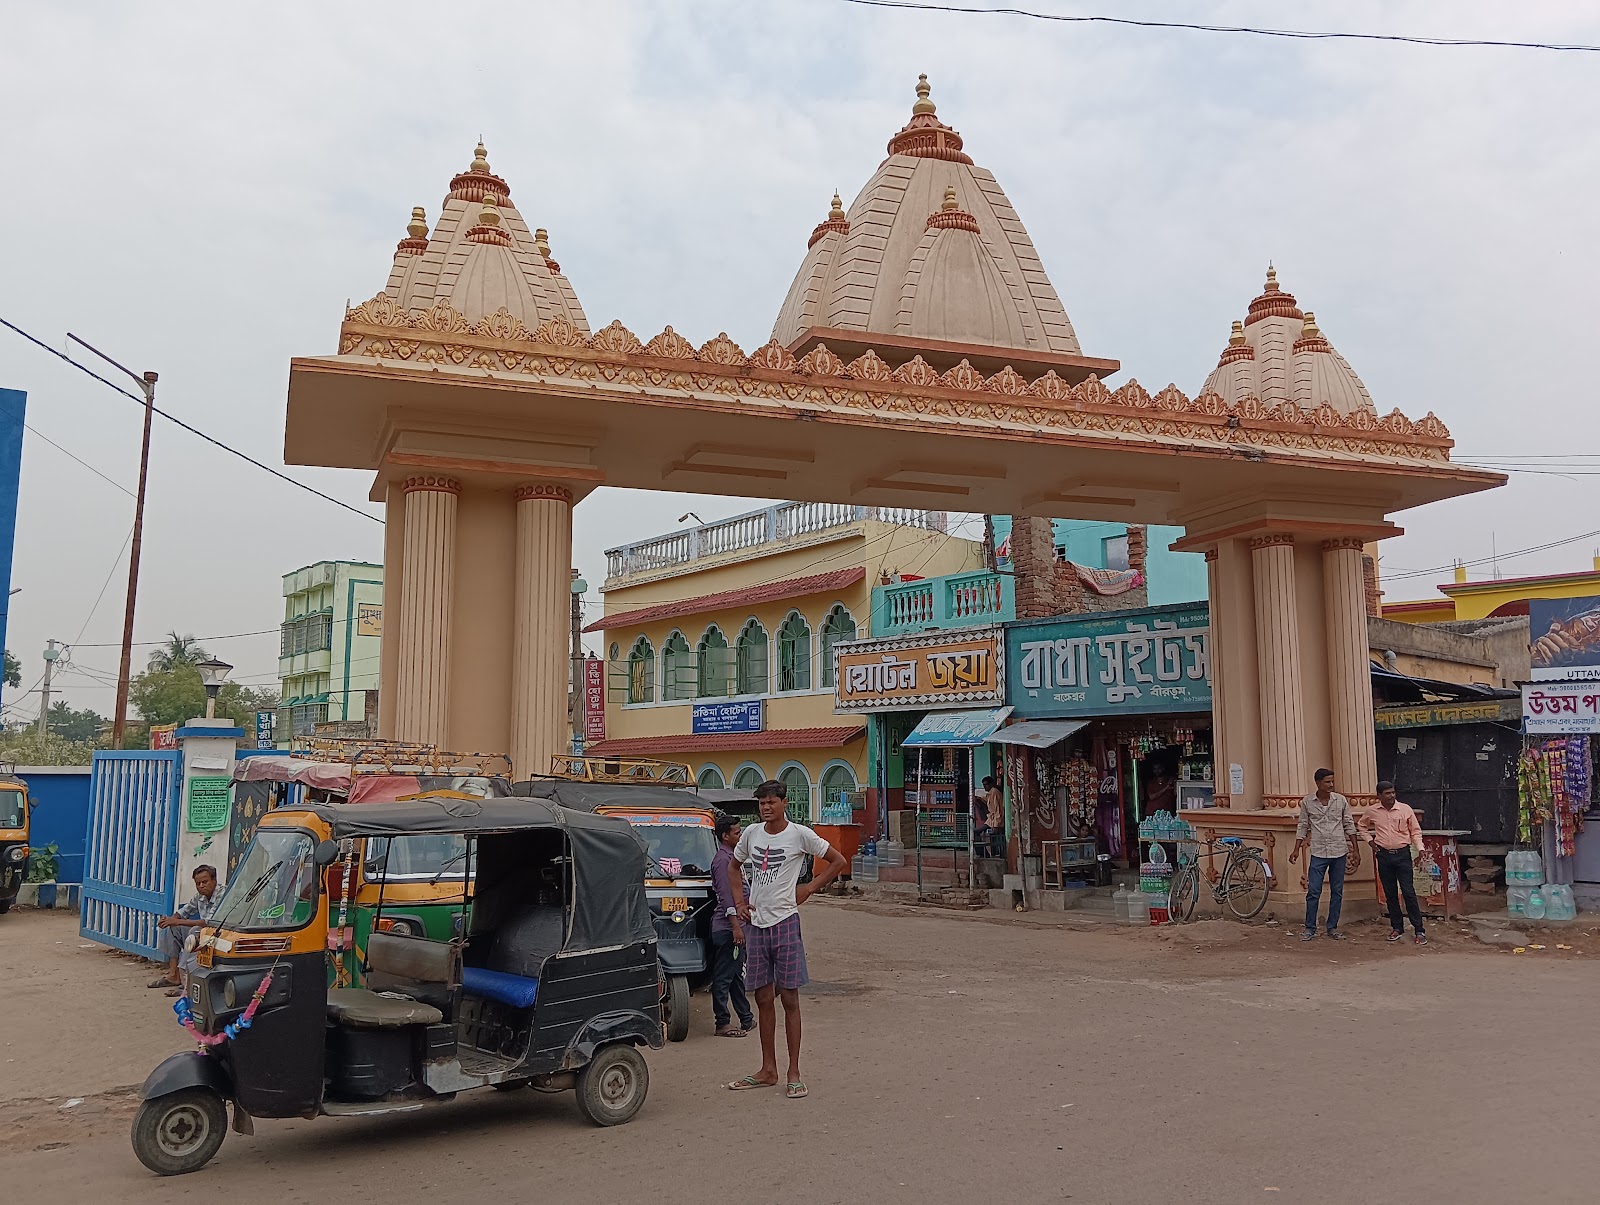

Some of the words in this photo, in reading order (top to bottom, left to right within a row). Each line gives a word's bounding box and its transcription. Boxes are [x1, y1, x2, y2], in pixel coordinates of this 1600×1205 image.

[845, 654, 917, 694] হোটেল
[926, 650, 991, 689] জয়া
[1020, 637, 1091, 698] রাধা
[693, 706, 718, 718] প্রতিমা
[720, 704, 748, 716] হোটেল
[1528, 690, 1578, 714] উত্তম
[1582, 694, 1600, 714] প
